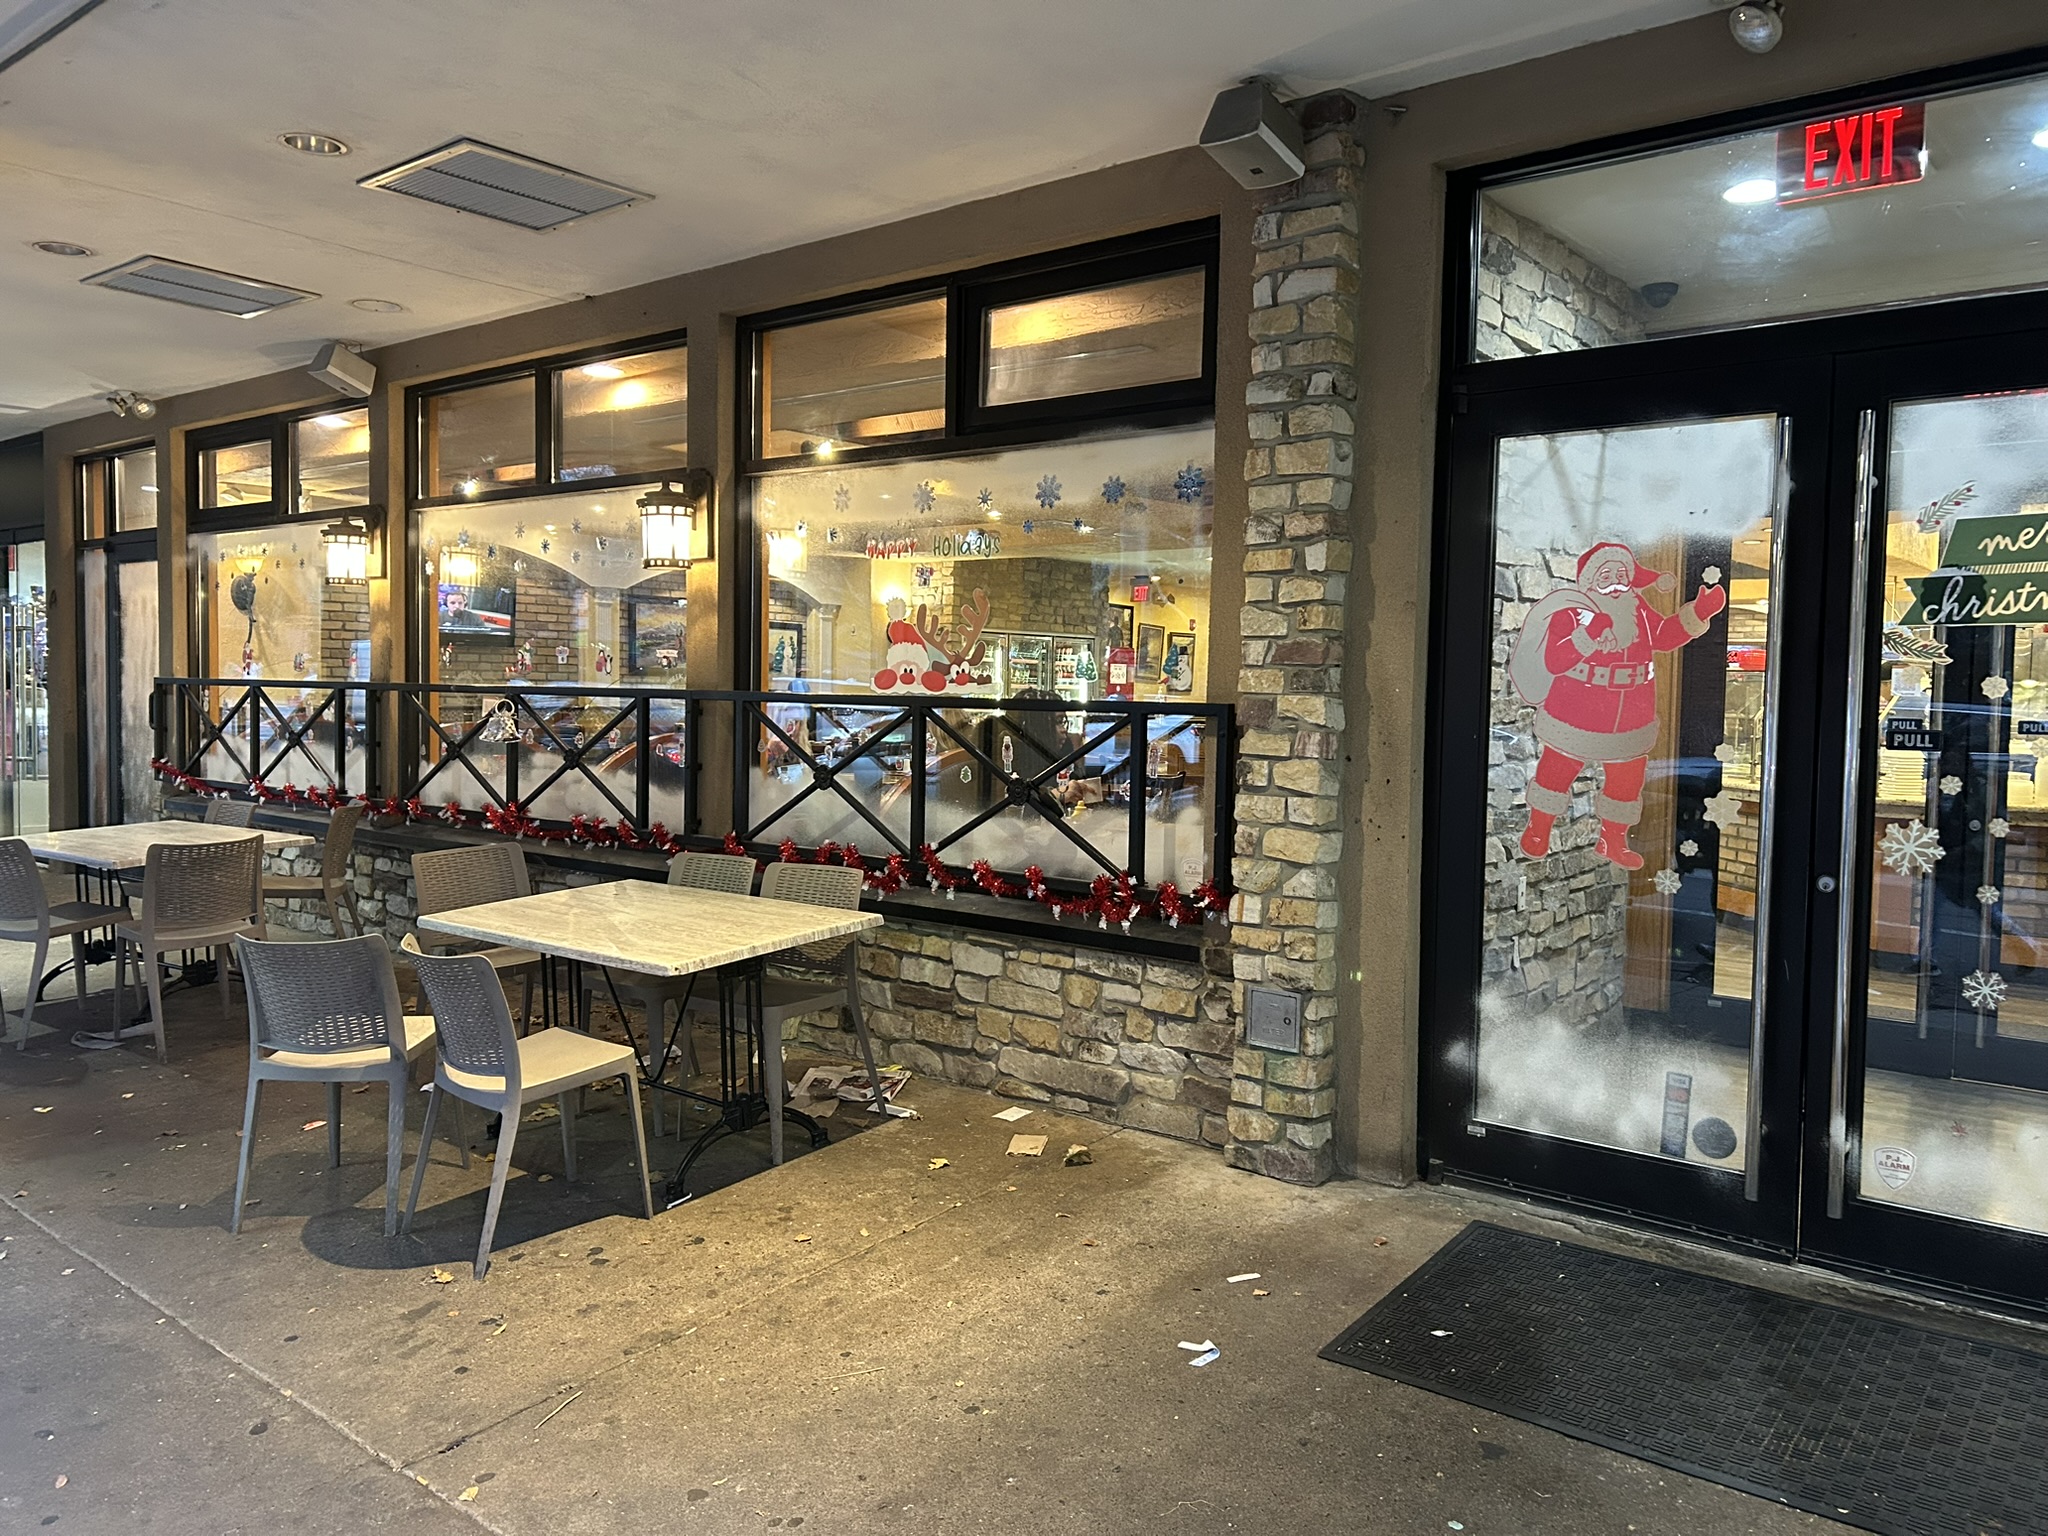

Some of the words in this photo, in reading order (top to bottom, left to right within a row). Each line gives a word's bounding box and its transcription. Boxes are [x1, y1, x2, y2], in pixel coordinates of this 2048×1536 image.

[1804, 106, 1903, 191] EXIT
[866, 538, 917, 559] HAPPY
[1892, 720, 1917, 730] PULL
[1893, 733, 1933, 747] PULL
[1886, 1154, 1902, 1162] P.J.
[1878, 1160, 1910, 1170] ALARM
